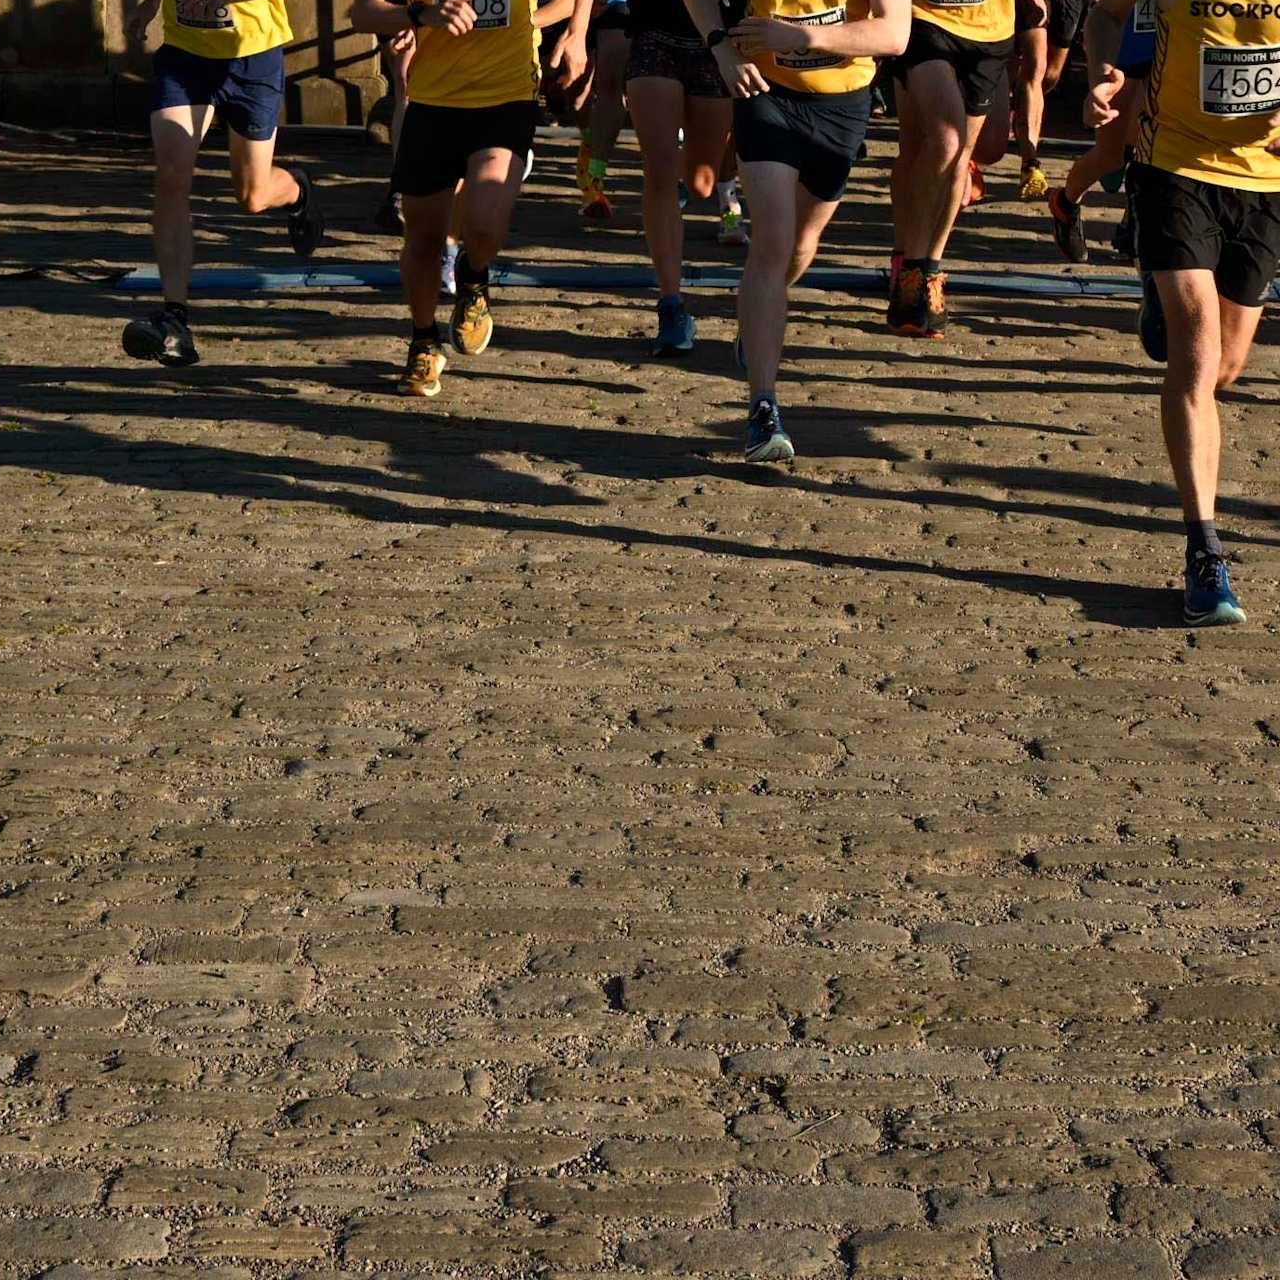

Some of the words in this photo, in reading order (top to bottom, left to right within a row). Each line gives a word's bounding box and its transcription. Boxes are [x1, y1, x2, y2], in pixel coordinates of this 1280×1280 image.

[1210, 51, 1232, 63] RUN
[1233, 49, 1267, 62] NORTH
[1231, 102, 1257, 112] RACE
